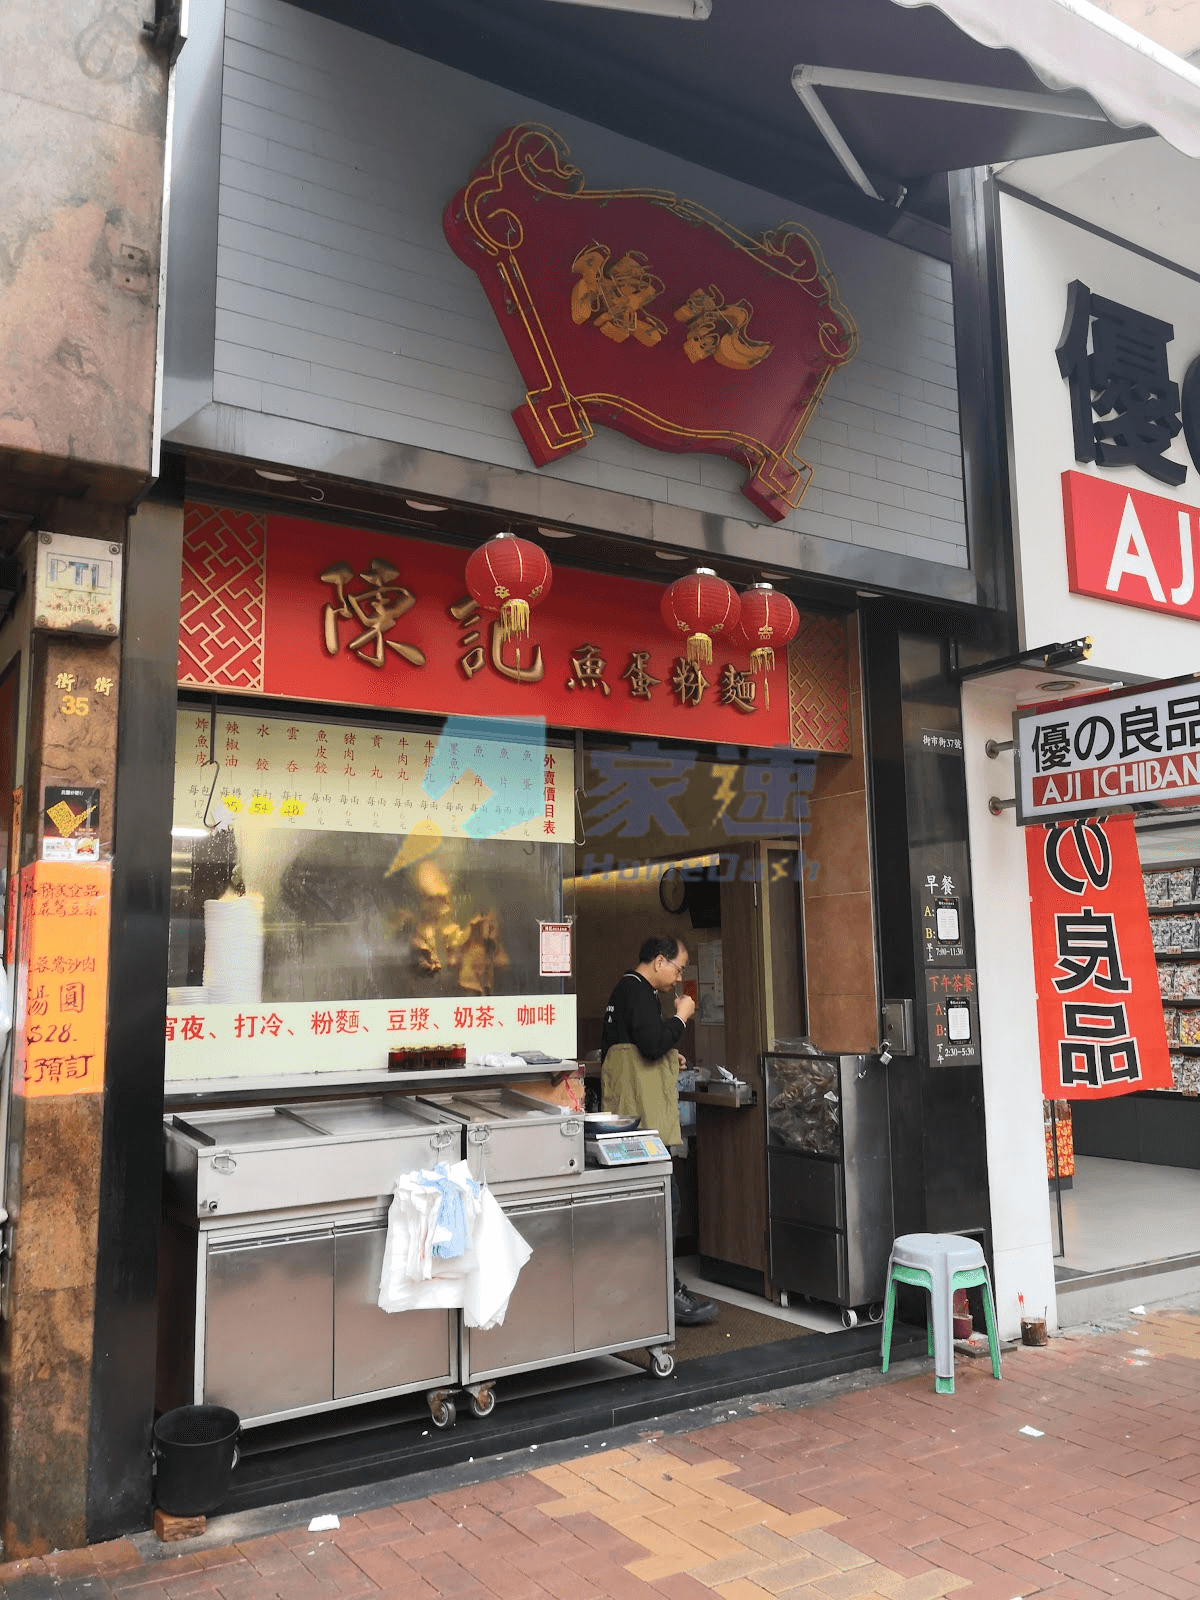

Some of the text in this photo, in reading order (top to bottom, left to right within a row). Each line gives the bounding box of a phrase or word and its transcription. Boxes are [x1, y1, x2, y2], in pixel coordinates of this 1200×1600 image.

[1055, 278, 1200, 488] 優
[1105, 492, 1200, 606] AJ
[55, 672, 114, 696] 街 街
[567, 643, 758, 712] 魚蛋粉麵
[61, 695, 89, 716] 35
[195, 717, 209, 766] 炸魚皮
[225, 721, 240, 767] 辣椒油
[1032, 695, 1200, 773] 優の良品
[315, 729, 328, 774] 魚皮餃
[343, 732, 356, 777] 豬肉丸
[371, 735, 383, 779] 貢丸
[398, 737, 409, 781] 牛肉丸
[1042, 753, 1200, 804] AJI ICHIBAN
[253, 804, 268, 813] 54
[543, 754, 556, 835] 外賣價目表
[925, 875, 955, 895] 早餐
[924, 905, 935, 917] A:
[925, 928, 936, 939] B:
[926, 943, 934, 962] 早上
[28, 982, 85, 1015] 湯圓
[929, 974, 974, 993] 下午茶餐
[936, 1003, 946, 1016] A:
[936, 1024, 947, 1036] B:
[937, 1043, 944, 1064] 下午
[945, 1047, 975, 1057] 2:30-5:30
[25, 1054, 96, 1084] 預訂
